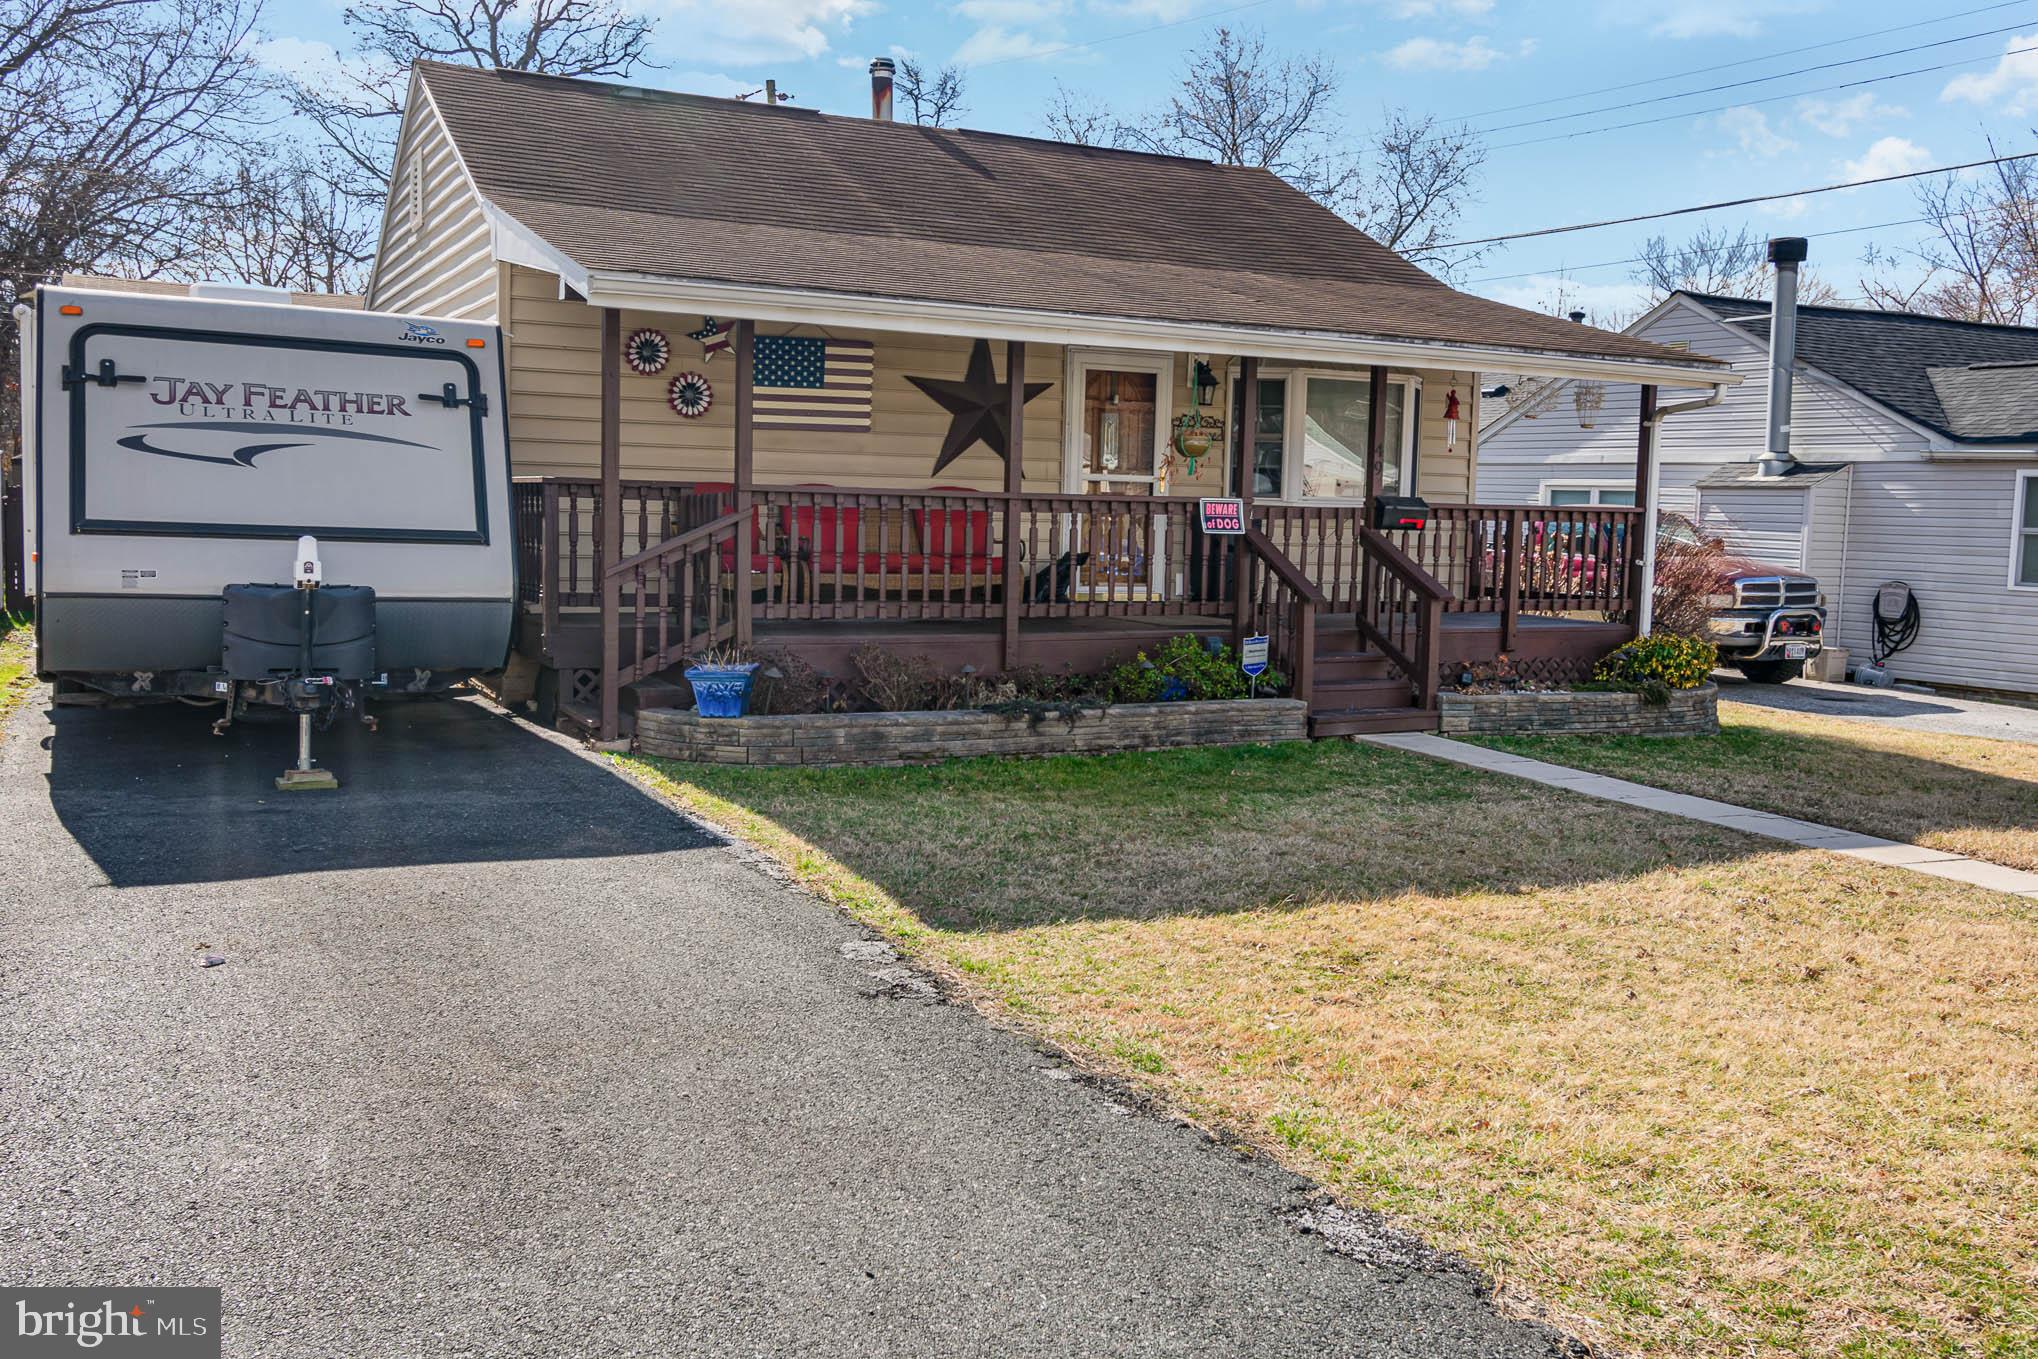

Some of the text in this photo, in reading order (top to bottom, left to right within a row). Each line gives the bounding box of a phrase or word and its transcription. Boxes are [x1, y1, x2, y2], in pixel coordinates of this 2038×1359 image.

[398, 332, 446, 344] Jayco
[150, 376, 412, 417] JAY FEATHER
[179, 402, 354, 425] ULTRA LITE
[1206, 503, 1238, 515] BEWARE
[1207, 518, 1240, 529] of DOG
